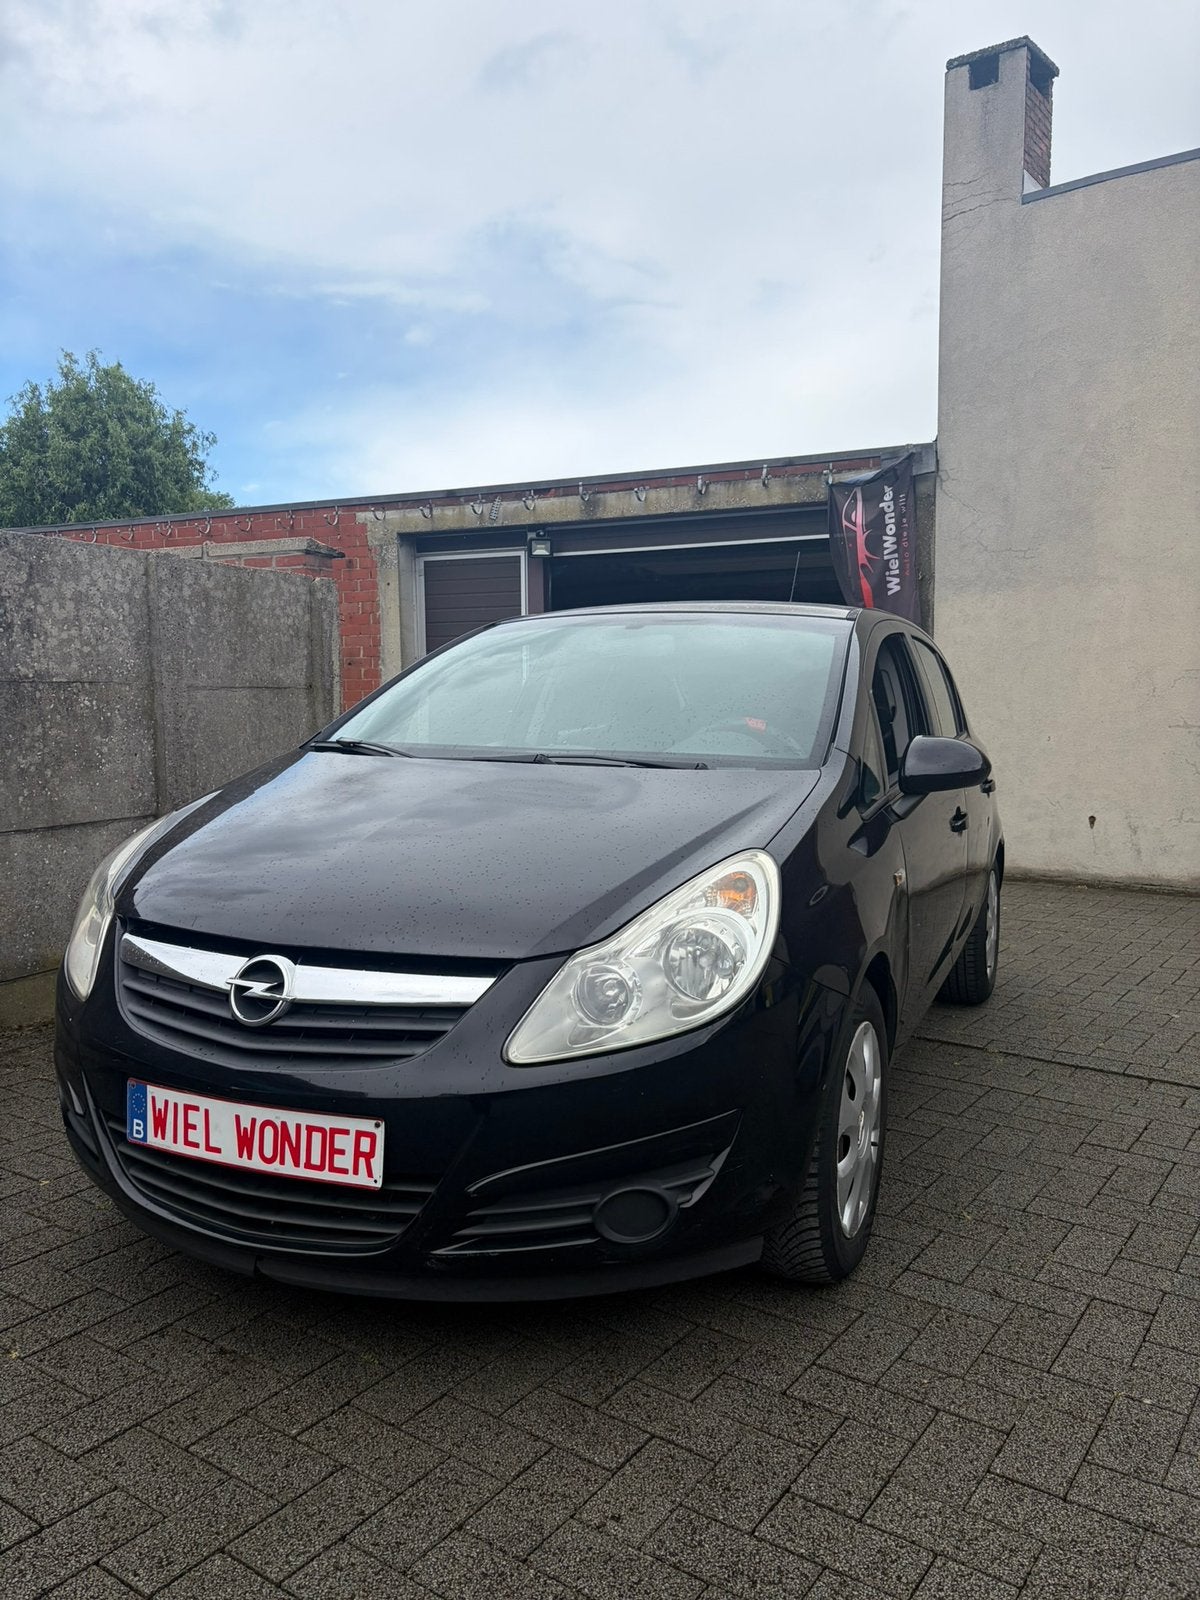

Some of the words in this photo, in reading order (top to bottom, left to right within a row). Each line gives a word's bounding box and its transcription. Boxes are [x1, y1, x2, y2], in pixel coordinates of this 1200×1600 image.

[879, 485, 901, 596] WielWonder
[133, 1119, 144, 1138] B
[151, 1095, 222, 1154] WIEL
[235, 1114, 377, 1179] WONDER
